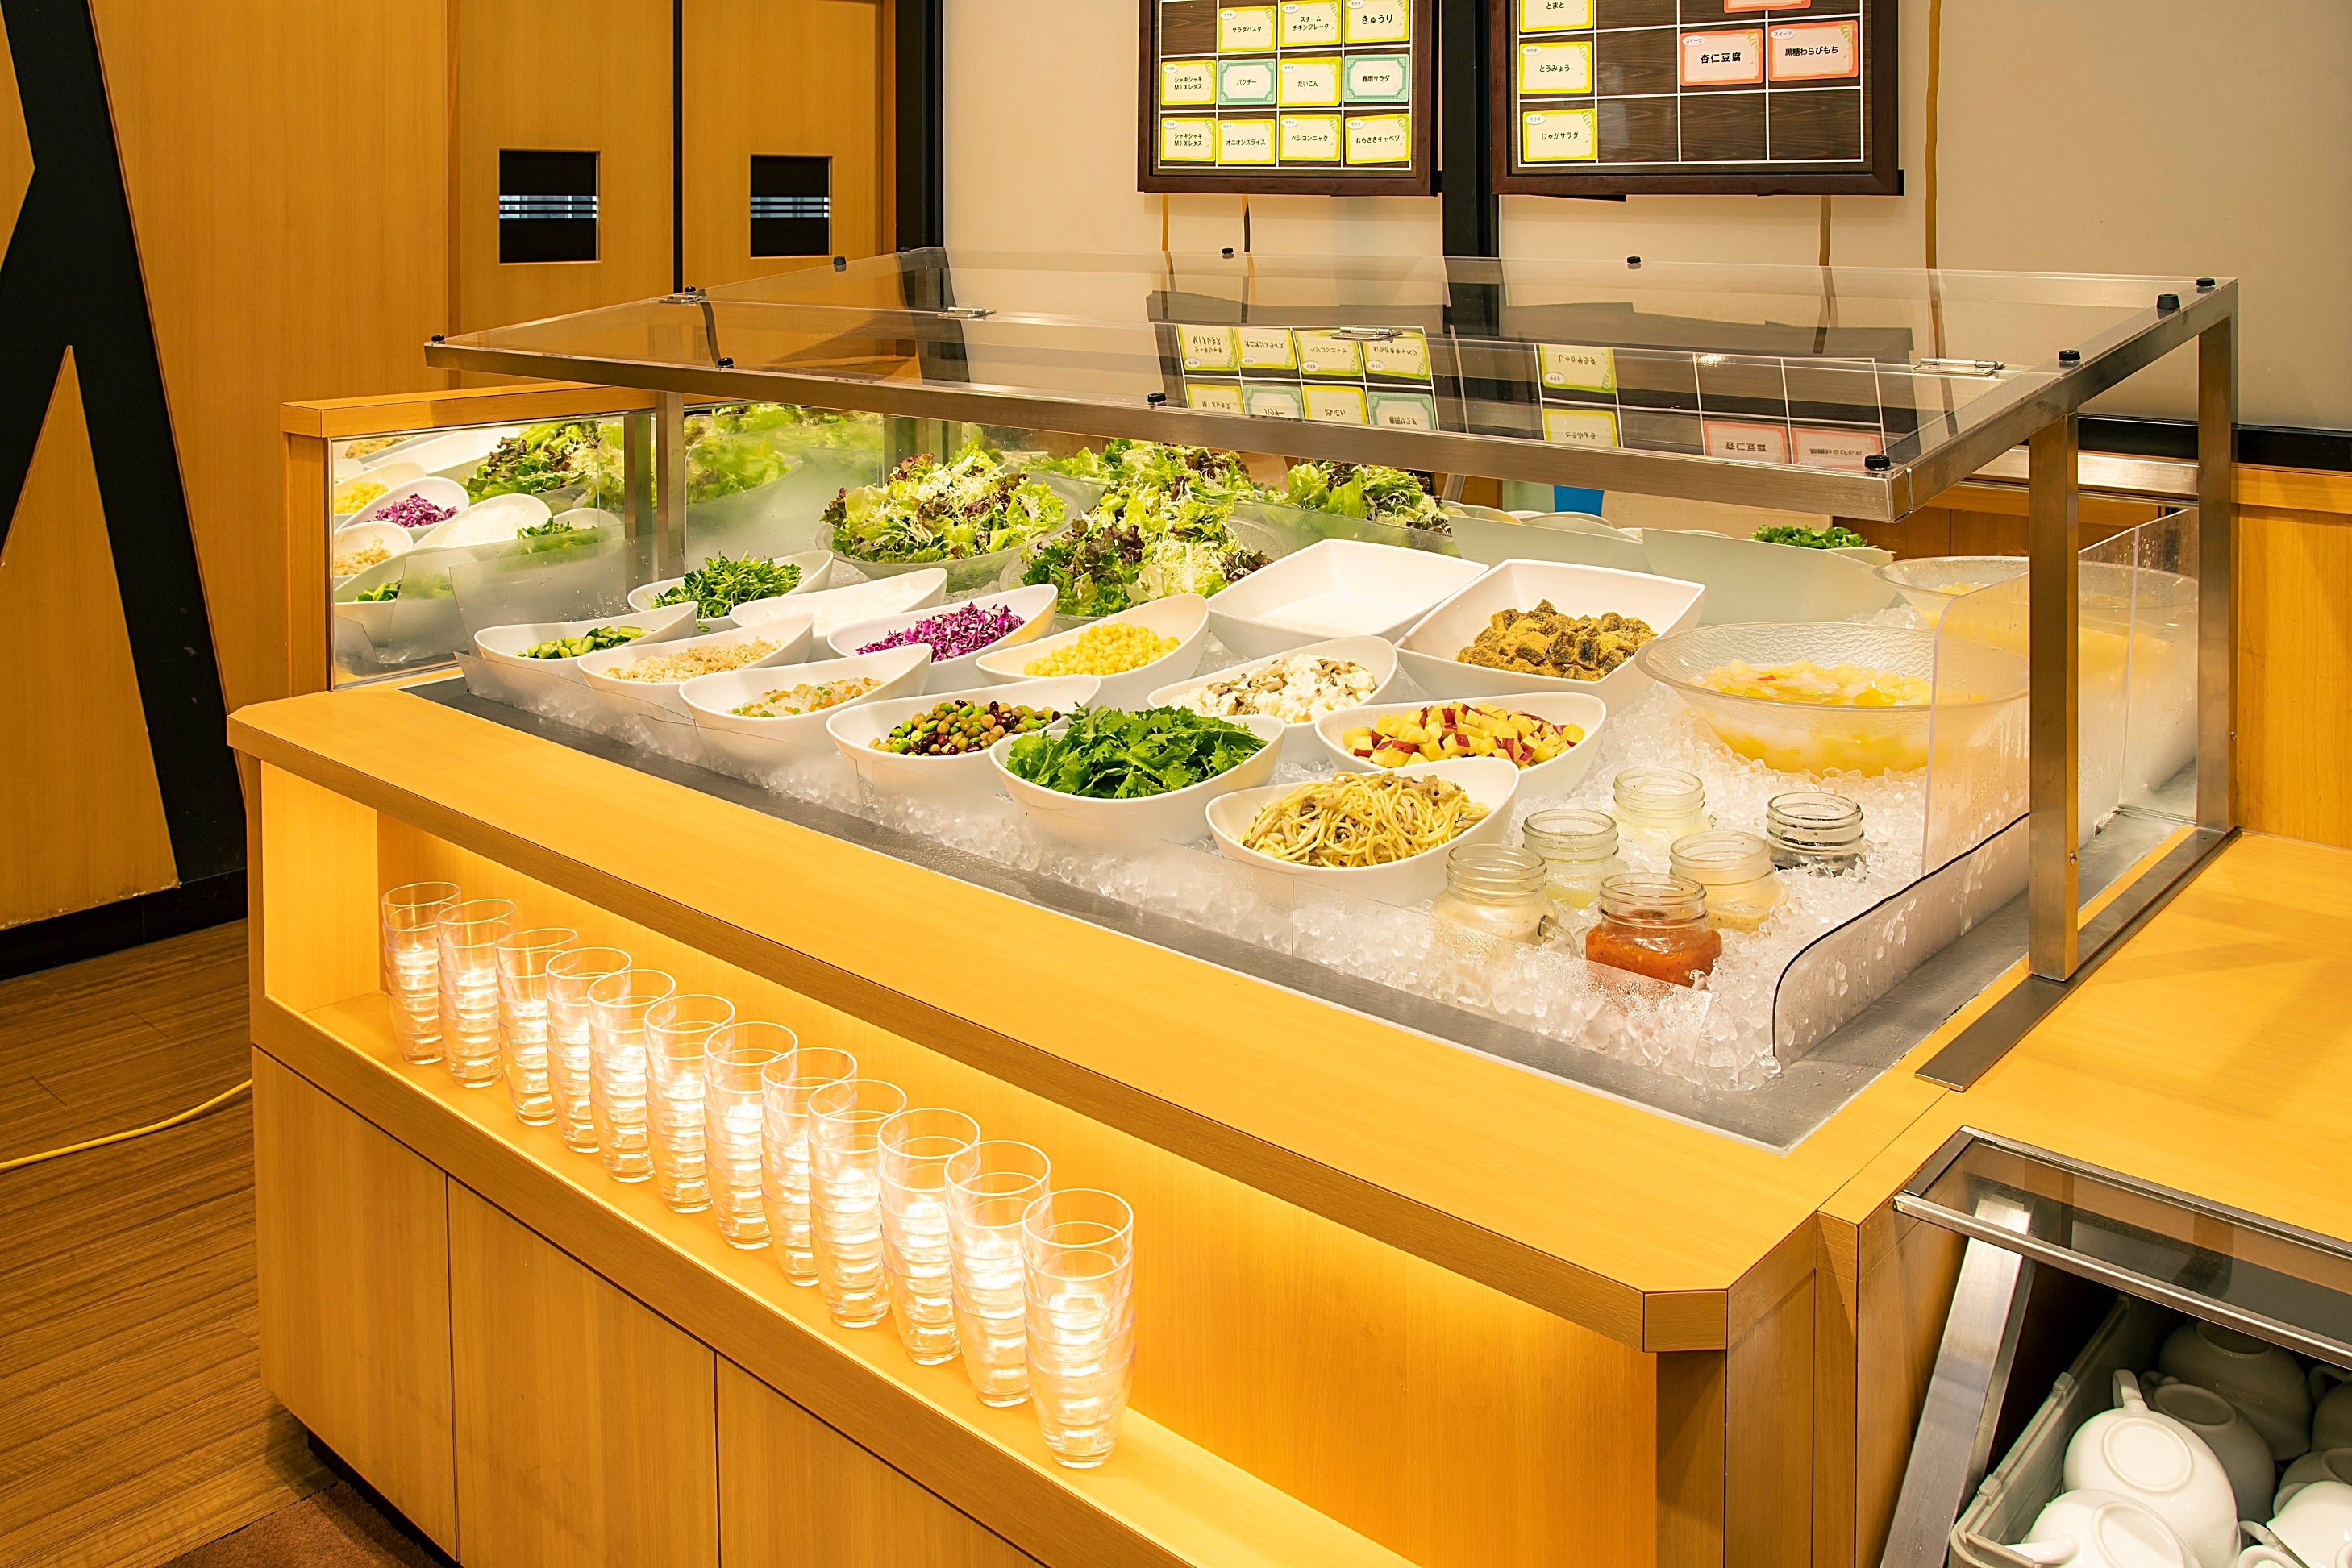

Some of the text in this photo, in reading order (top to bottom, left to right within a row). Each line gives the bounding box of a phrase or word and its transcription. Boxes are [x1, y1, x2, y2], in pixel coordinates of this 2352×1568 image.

[1546, 1, 1564, 10] とまと
[1300, 15, 1322, 23] スチーム
[1361, 13, 1392, 25] きゅうり
[1292, 21, 1330, 31] チキンフレーク
[1773, 30, 1792, 38] スイーツ
[1784, 45, 1838, 57] 黒糖わらびもち
[1700, 52, 1742, 64] 杏仁豆腐
[1539, 64, 1570, 73] とうみょう
[1362, 74, 1390, 82] 春雨サラダ
[1297, 80, 1319, 88] だいこん
[1355, 135, 1400, 144] むらさきキャベツ
[1541, 131, 1579, 140] じゃがサラダ
